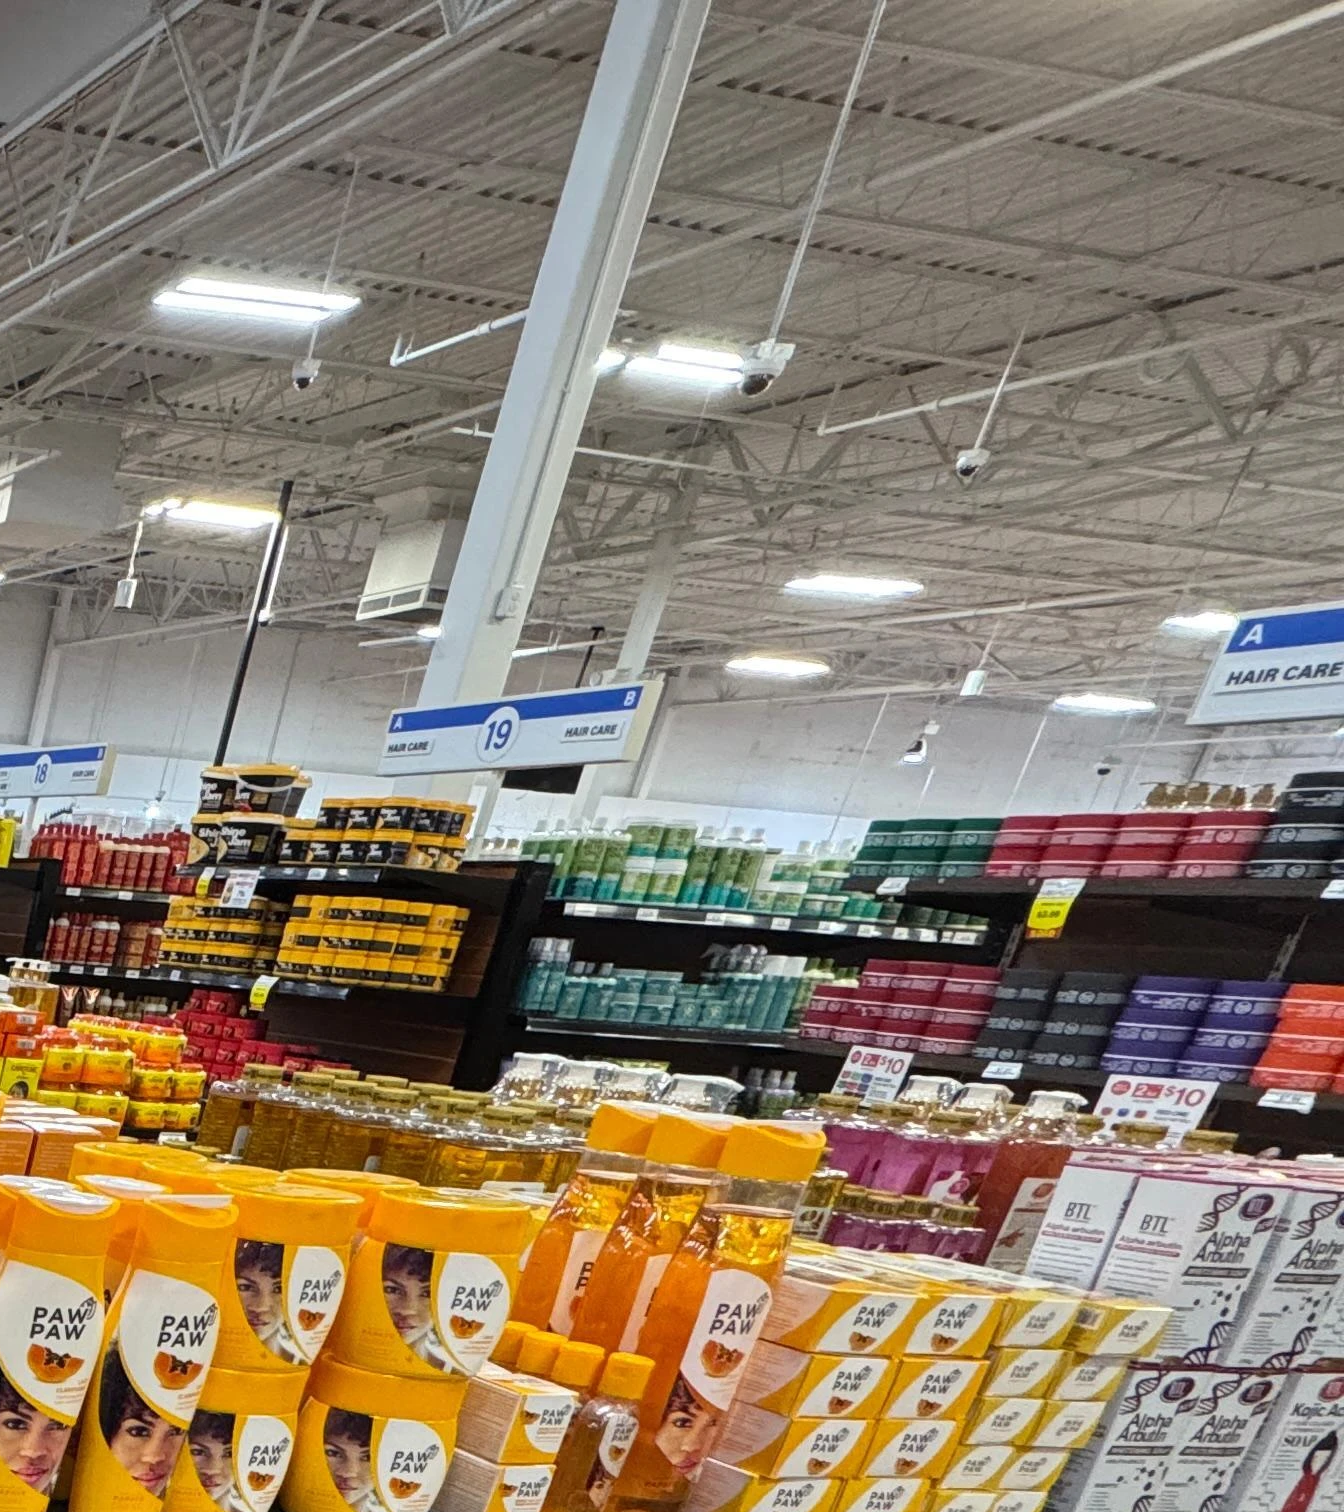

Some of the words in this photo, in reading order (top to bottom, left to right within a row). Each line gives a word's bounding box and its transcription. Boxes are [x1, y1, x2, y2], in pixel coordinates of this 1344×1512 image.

[1239, 624, 1264, 646] A
[1225, 668, 1279, 686] HAIR
[1283, 662, 1344, 680] CARE
[623, 691, 636, 707] B
[394, 716, 402, 730] A
[565, 726, 589, 738] HAIR
[591, 724, 618, 736] CARE
[484, 719, 512, 750] 19
[388, 742, 406, 753] HAIR
[408, 740, 429, 751] CARE
[34, 763, 48, 783] 18
[221, 827, 246, 836] Shine
[228, 839, 251, 850] Jam
[879, 1055, 905, 1074] $10
[1140, 1215, 1168, 1233] BTL
[33, 1306, 88, 1325] PAW
[29, 1323, 85, 1341] PAW
[1290, 1403, 1324, 1418] Kojic
[1130, 1413, 1173, 1429] Alpha
